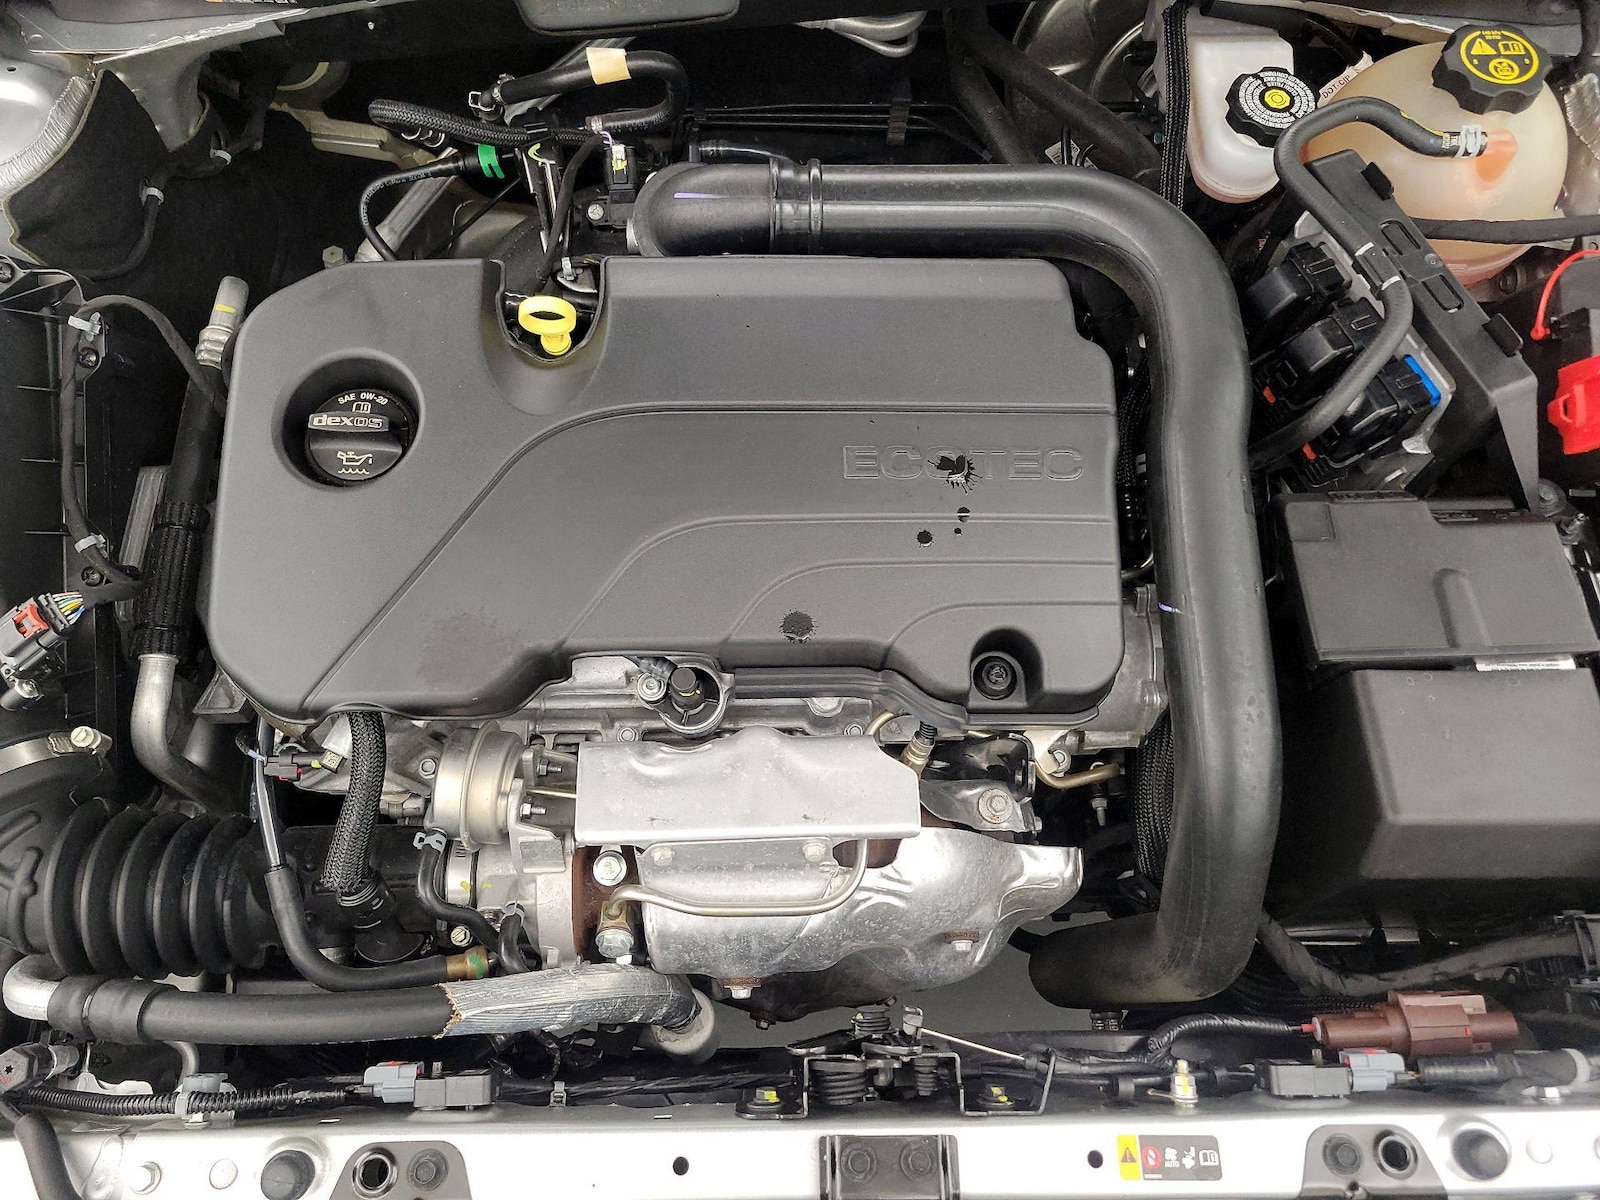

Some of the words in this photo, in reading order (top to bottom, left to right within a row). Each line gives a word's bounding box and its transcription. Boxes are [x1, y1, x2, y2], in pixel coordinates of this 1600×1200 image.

[338, 393, 356, 404] SAE
[360, 392, 388, 405] 0W-20
[313, 414, 382, 428] dexos
[843, 445, 1083, 481] ECOTEC
